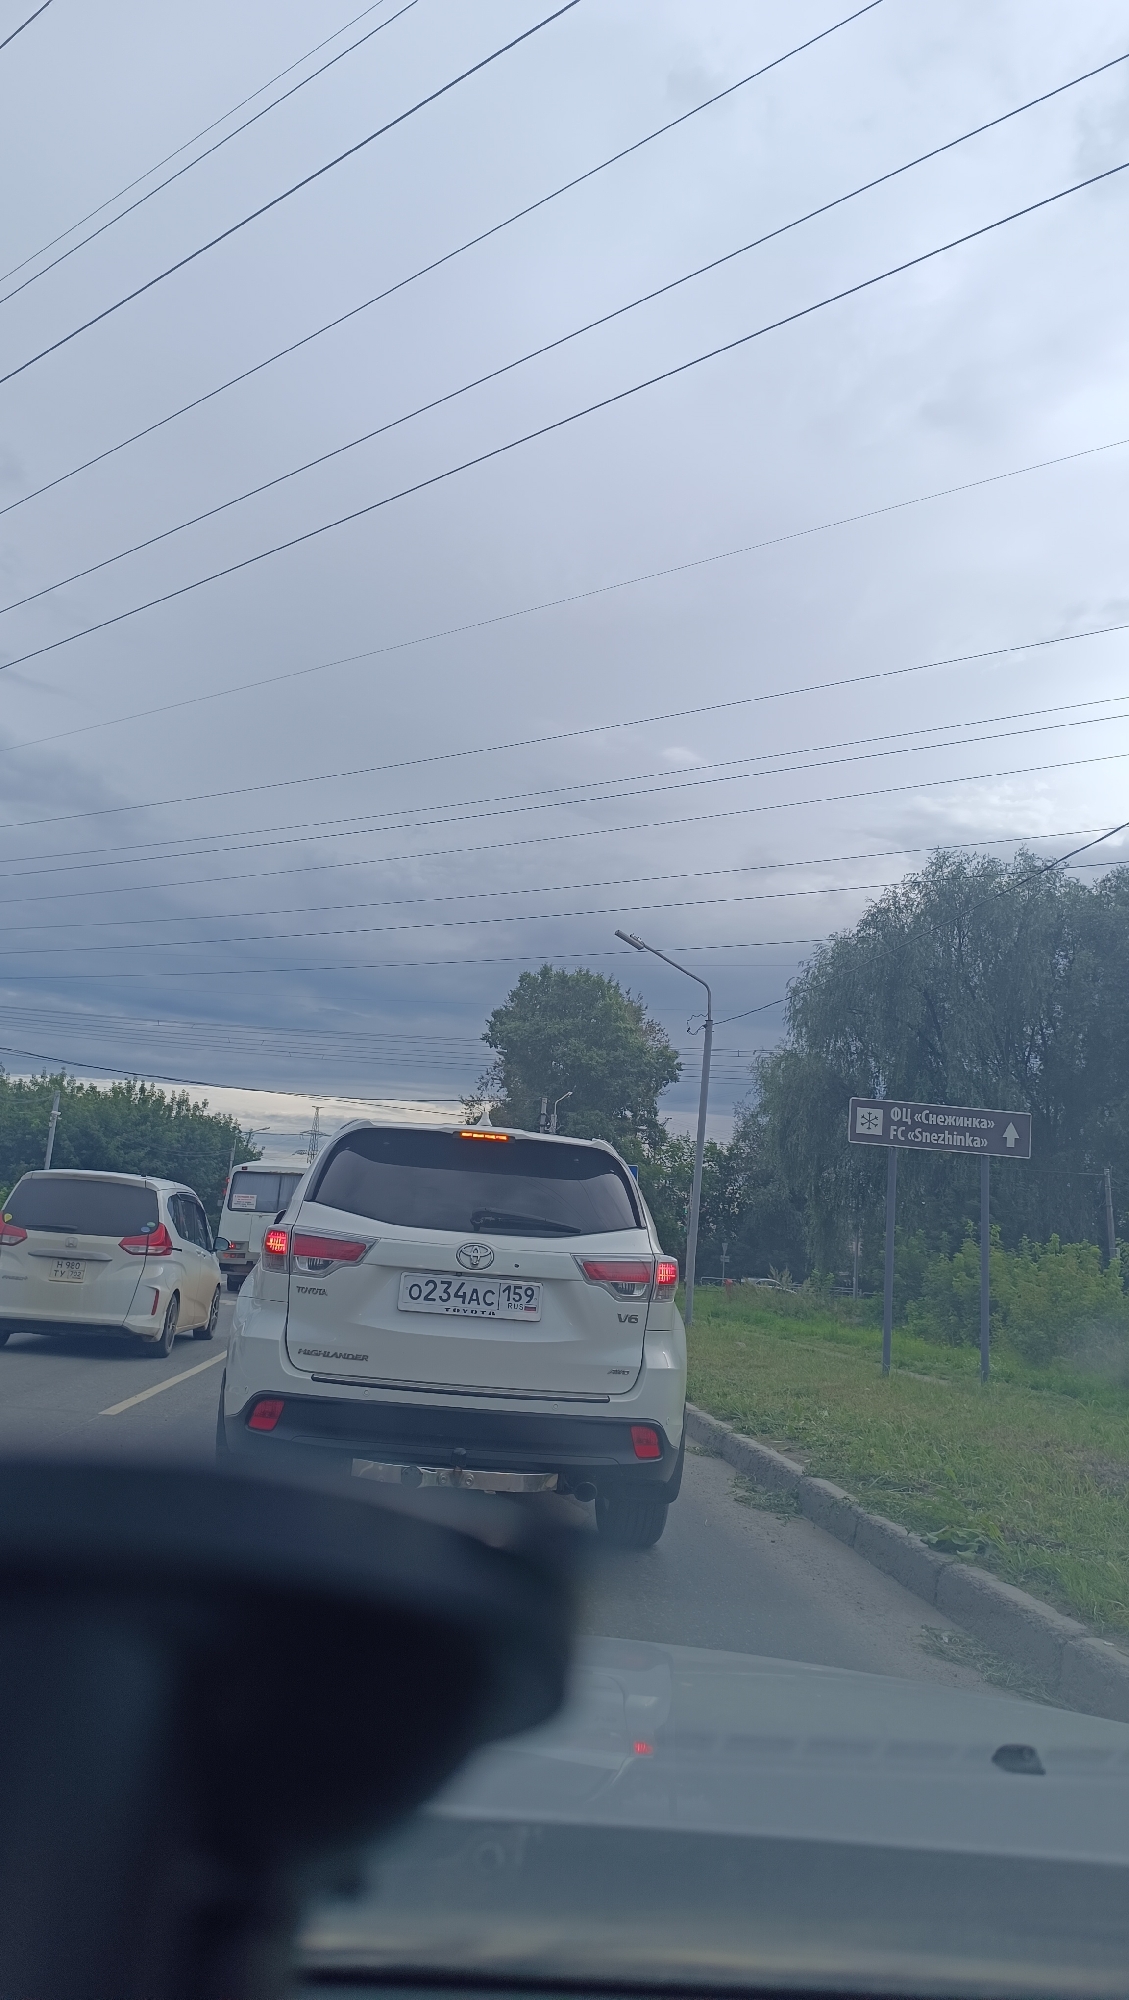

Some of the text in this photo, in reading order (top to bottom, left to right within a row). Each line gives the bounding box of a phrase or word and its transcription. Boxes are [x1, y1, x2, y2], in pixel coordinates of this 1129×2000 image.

[890, 1107, 995, 1129] ФЦ «Снежинка»
[890, 1126, 988, 1148] FC «Snezhinka»
[296, 1285, 328, 1296] TOYOTA
[502, 1284, 535, 1304] 159
[444, 1307, 496, 1316] TOYOTA
[507, 1302, 524, 1311] RUS
[617, 1313, 638, 1323] V6
[297, 1348, 369, 1362] HIGHLANDER
